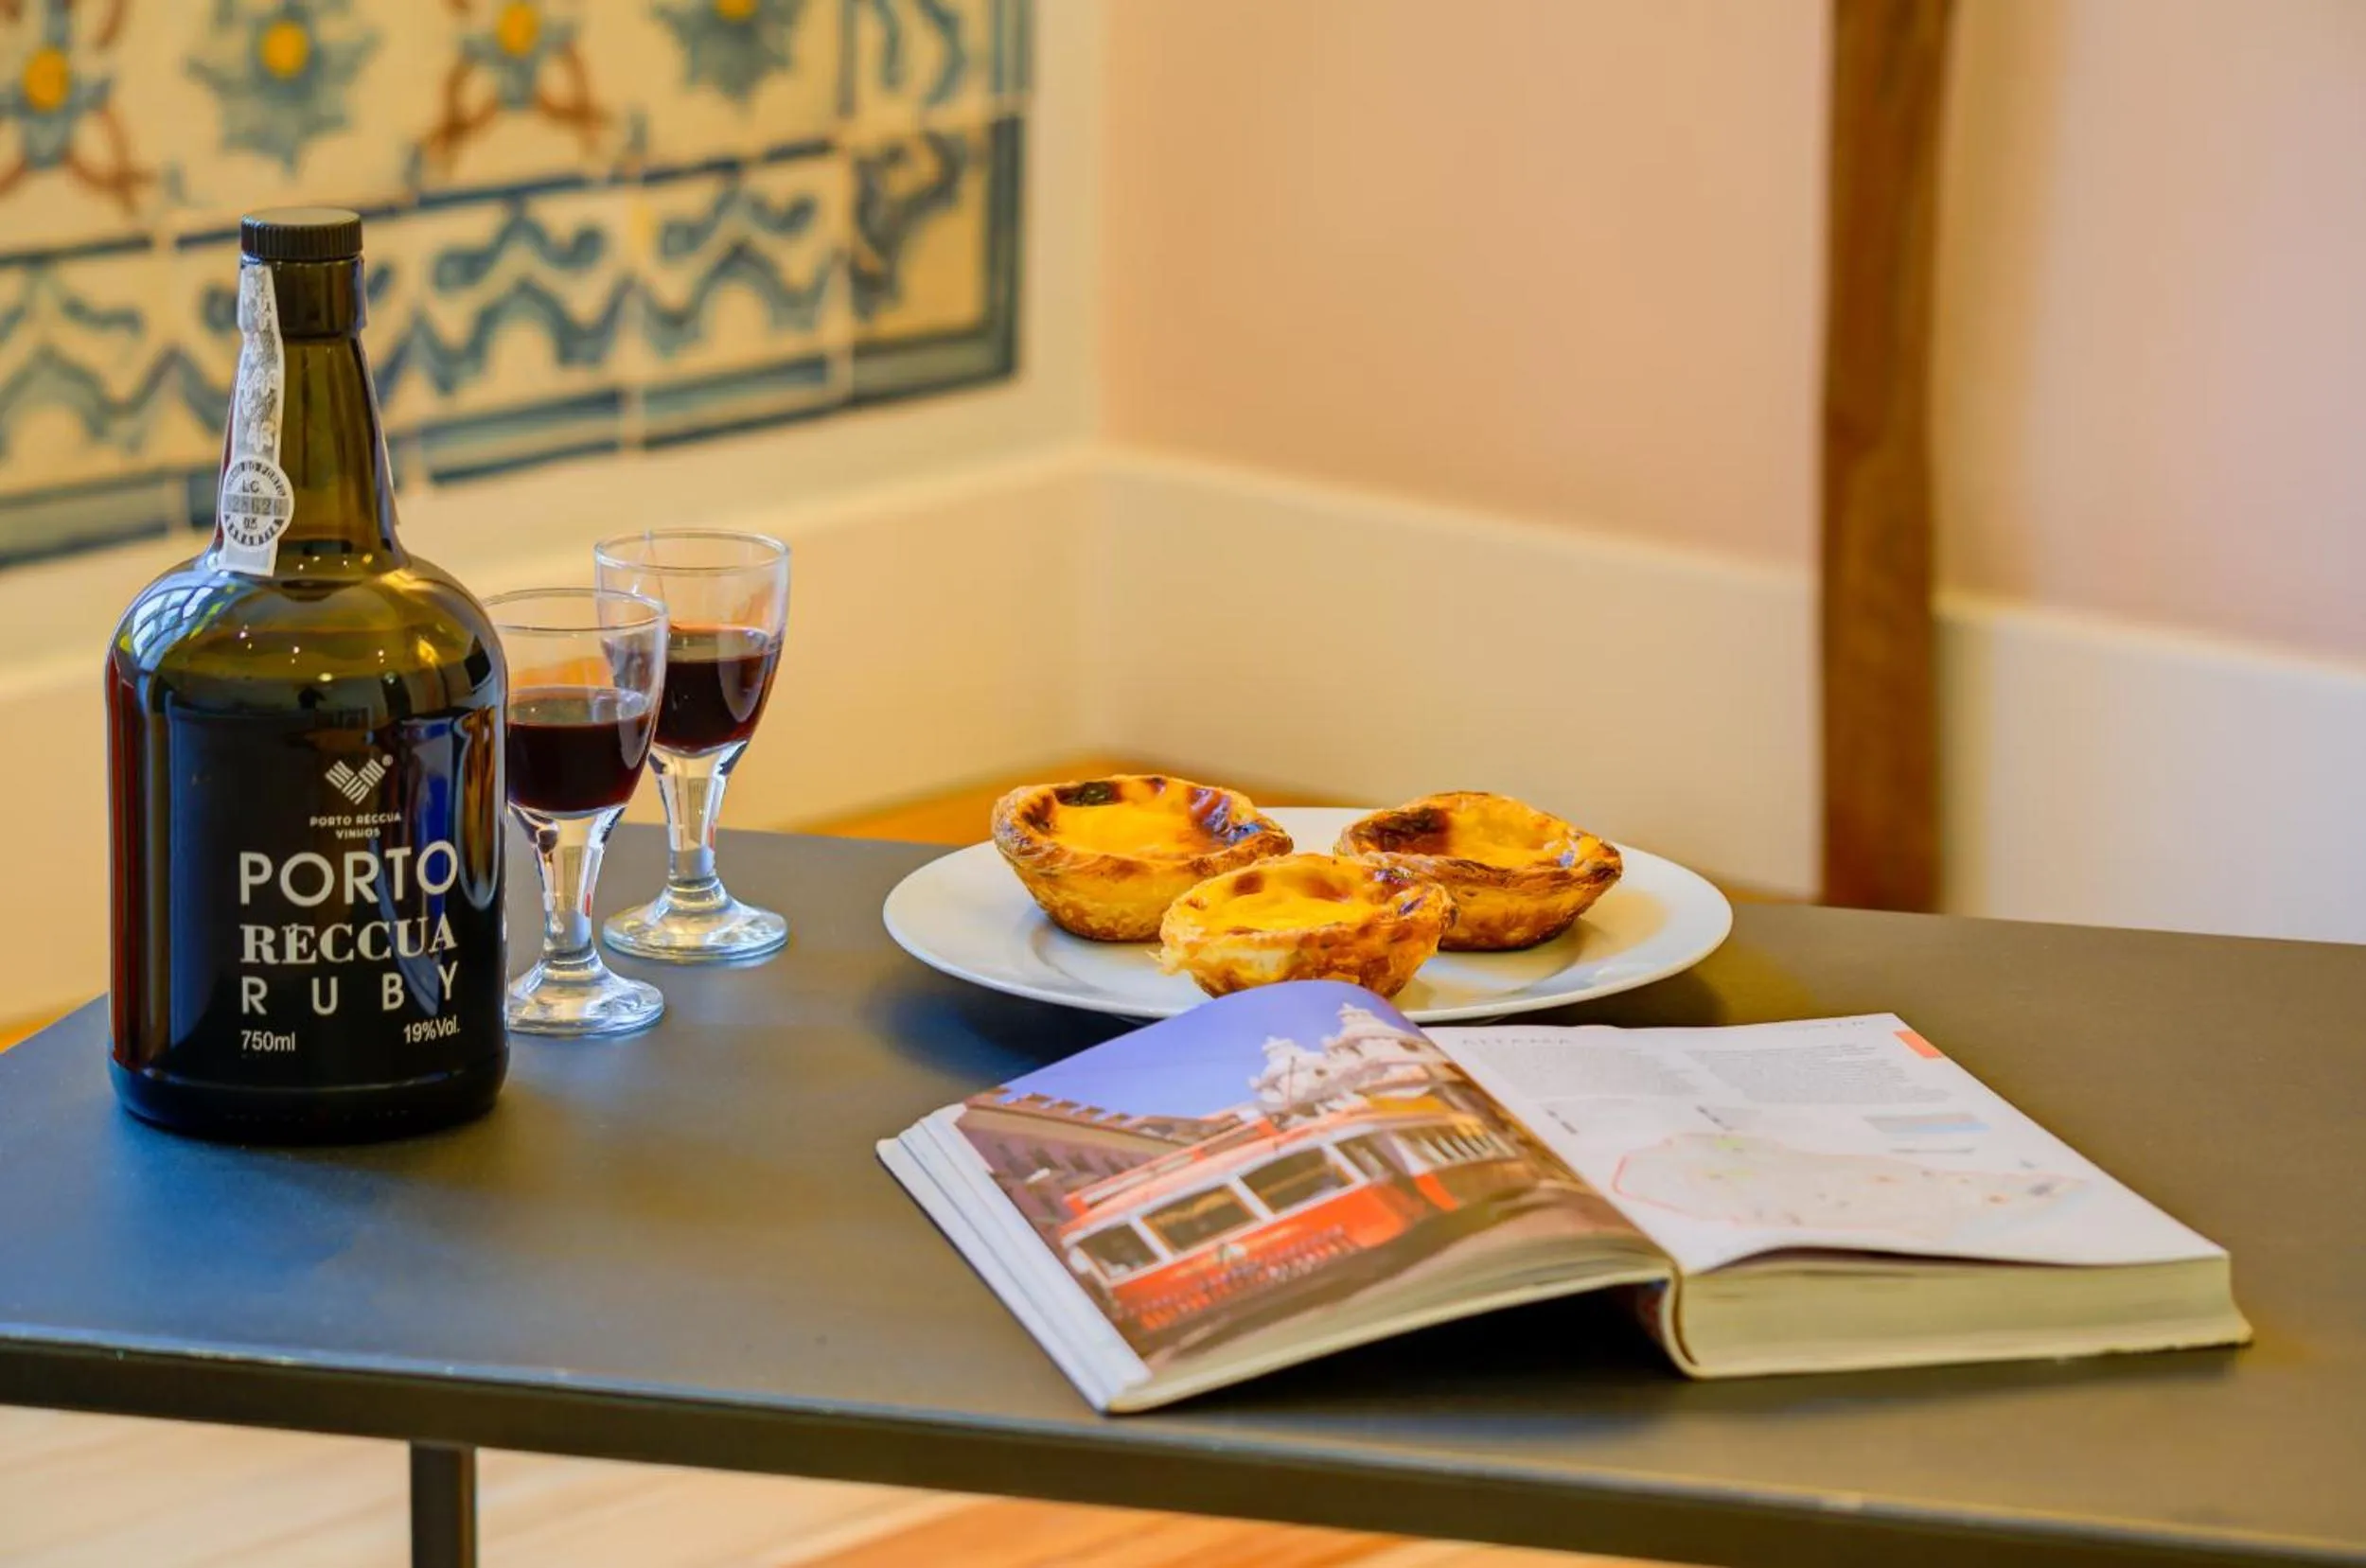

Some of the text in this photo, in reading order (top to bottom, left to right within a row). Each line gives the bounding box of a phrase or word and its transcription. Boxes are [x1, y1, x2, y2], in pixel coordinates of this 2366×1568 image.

[309, 815, 353, 828] PORTO
[335, 826, 381, 840] VINHOS
[239, 839, 459, 907] PORTO
[241, 960, 459, 1016] RUBY
[240, 1029, 296, 1052] 750ml
